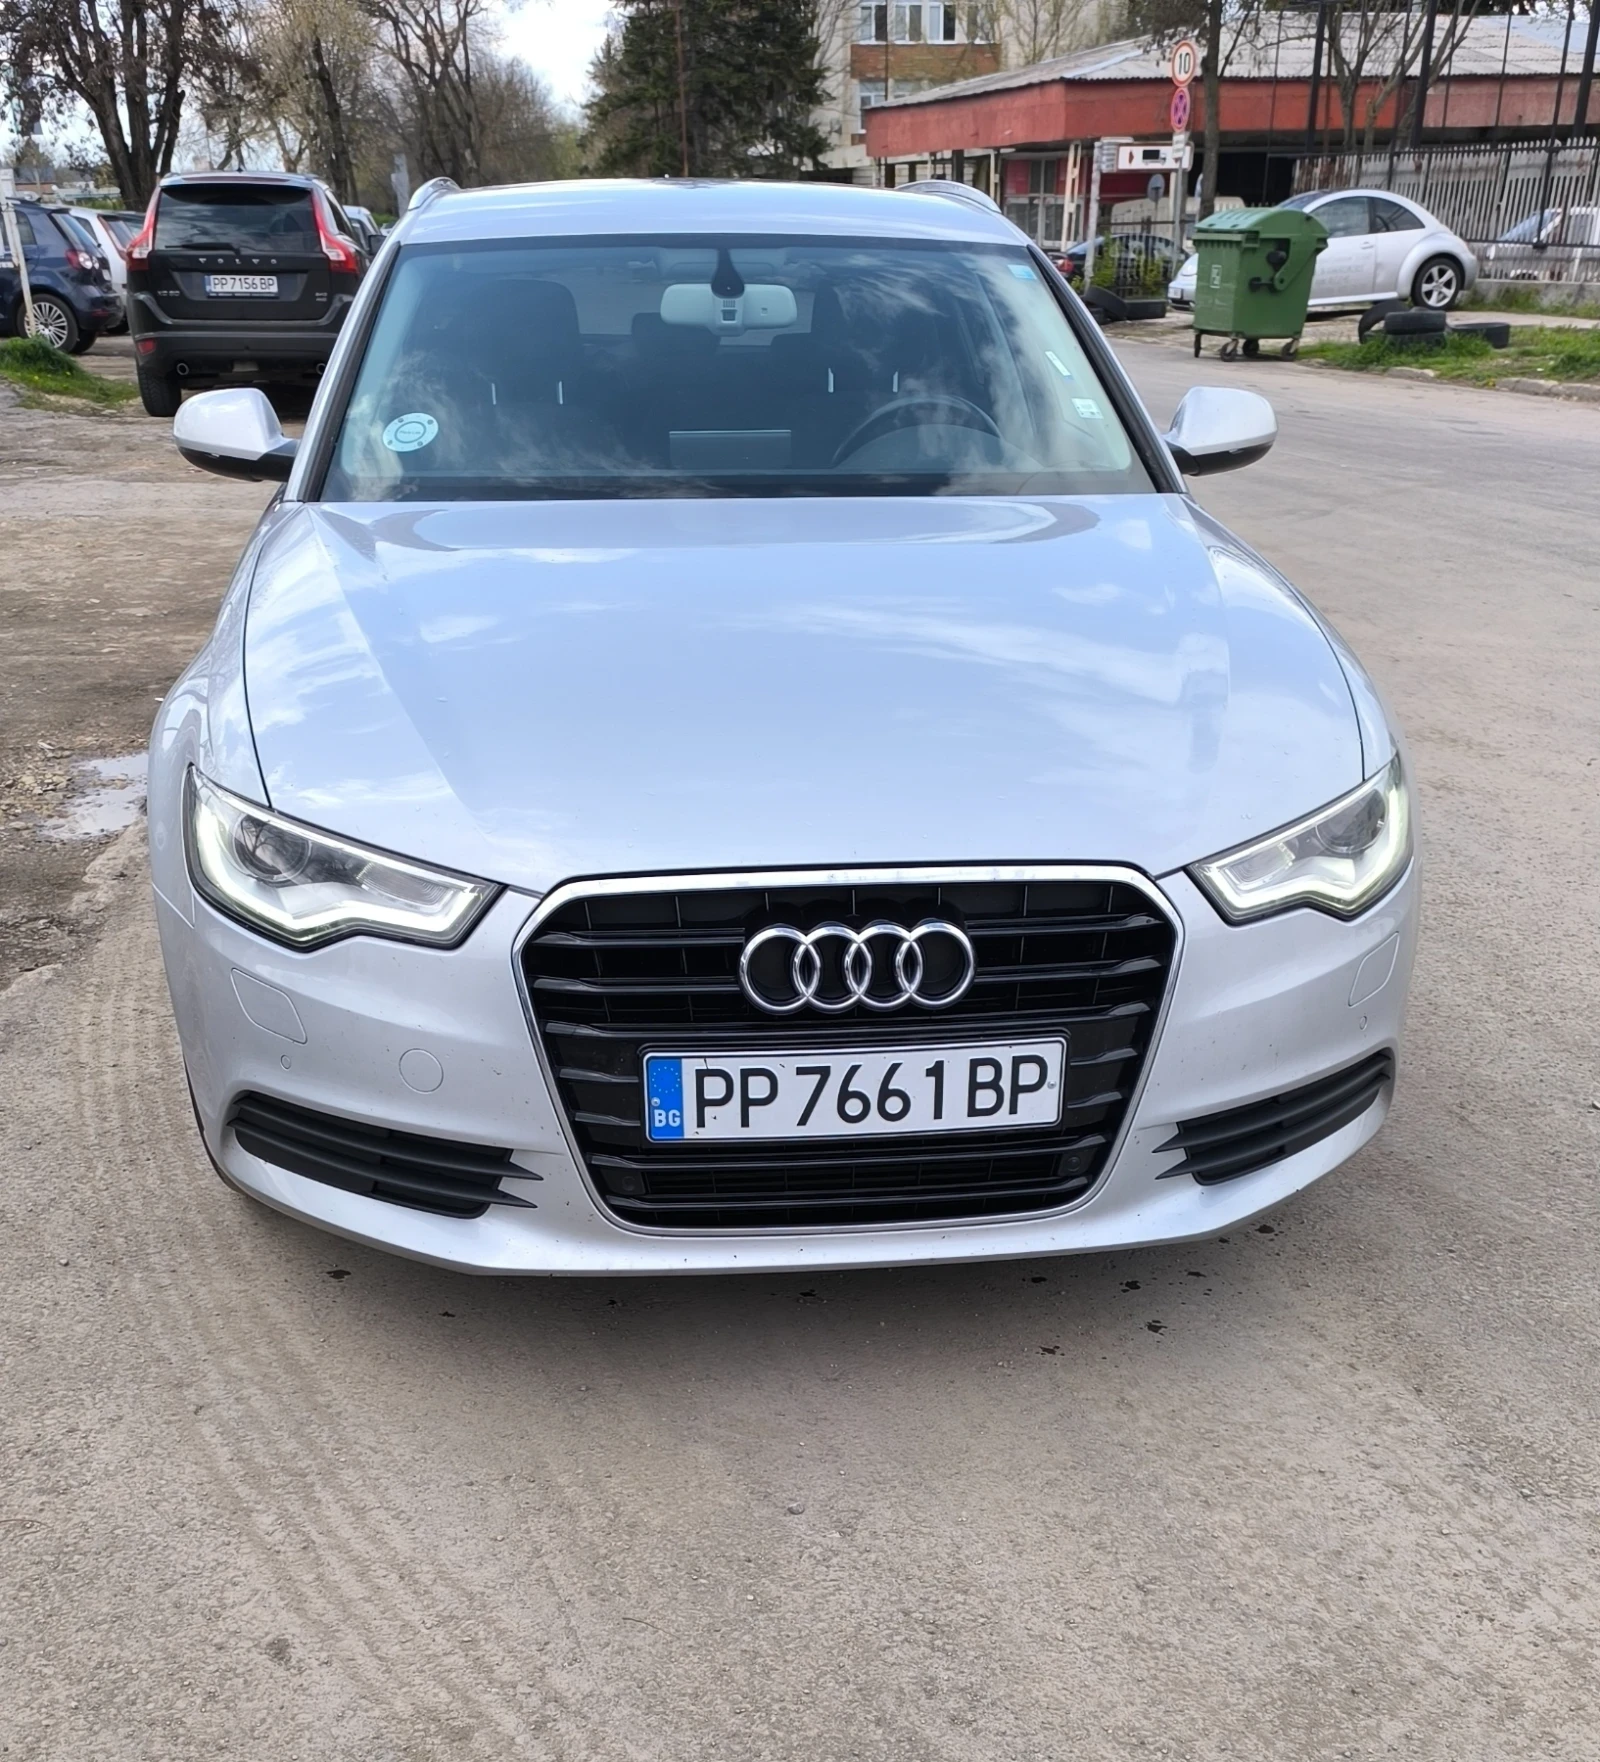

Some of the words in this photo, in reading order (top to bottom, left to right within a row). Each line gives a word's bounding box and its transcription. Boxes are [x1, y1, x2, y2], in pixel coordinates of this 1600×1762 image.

[1178, 52, 1190, 75] 10
[198, 257, 277, 265] VOLVO
[212, 277, 228, 290] PP
[230, 277, 258, 290] 7156
[259, 277, 275, 290] BP
[694, 1066, 779, 1128] PP
[795, 1060, 945, 1127] 7661
[967, 1054, 1049, 1118] BP
[653, 1109, 681, 1128] BG
